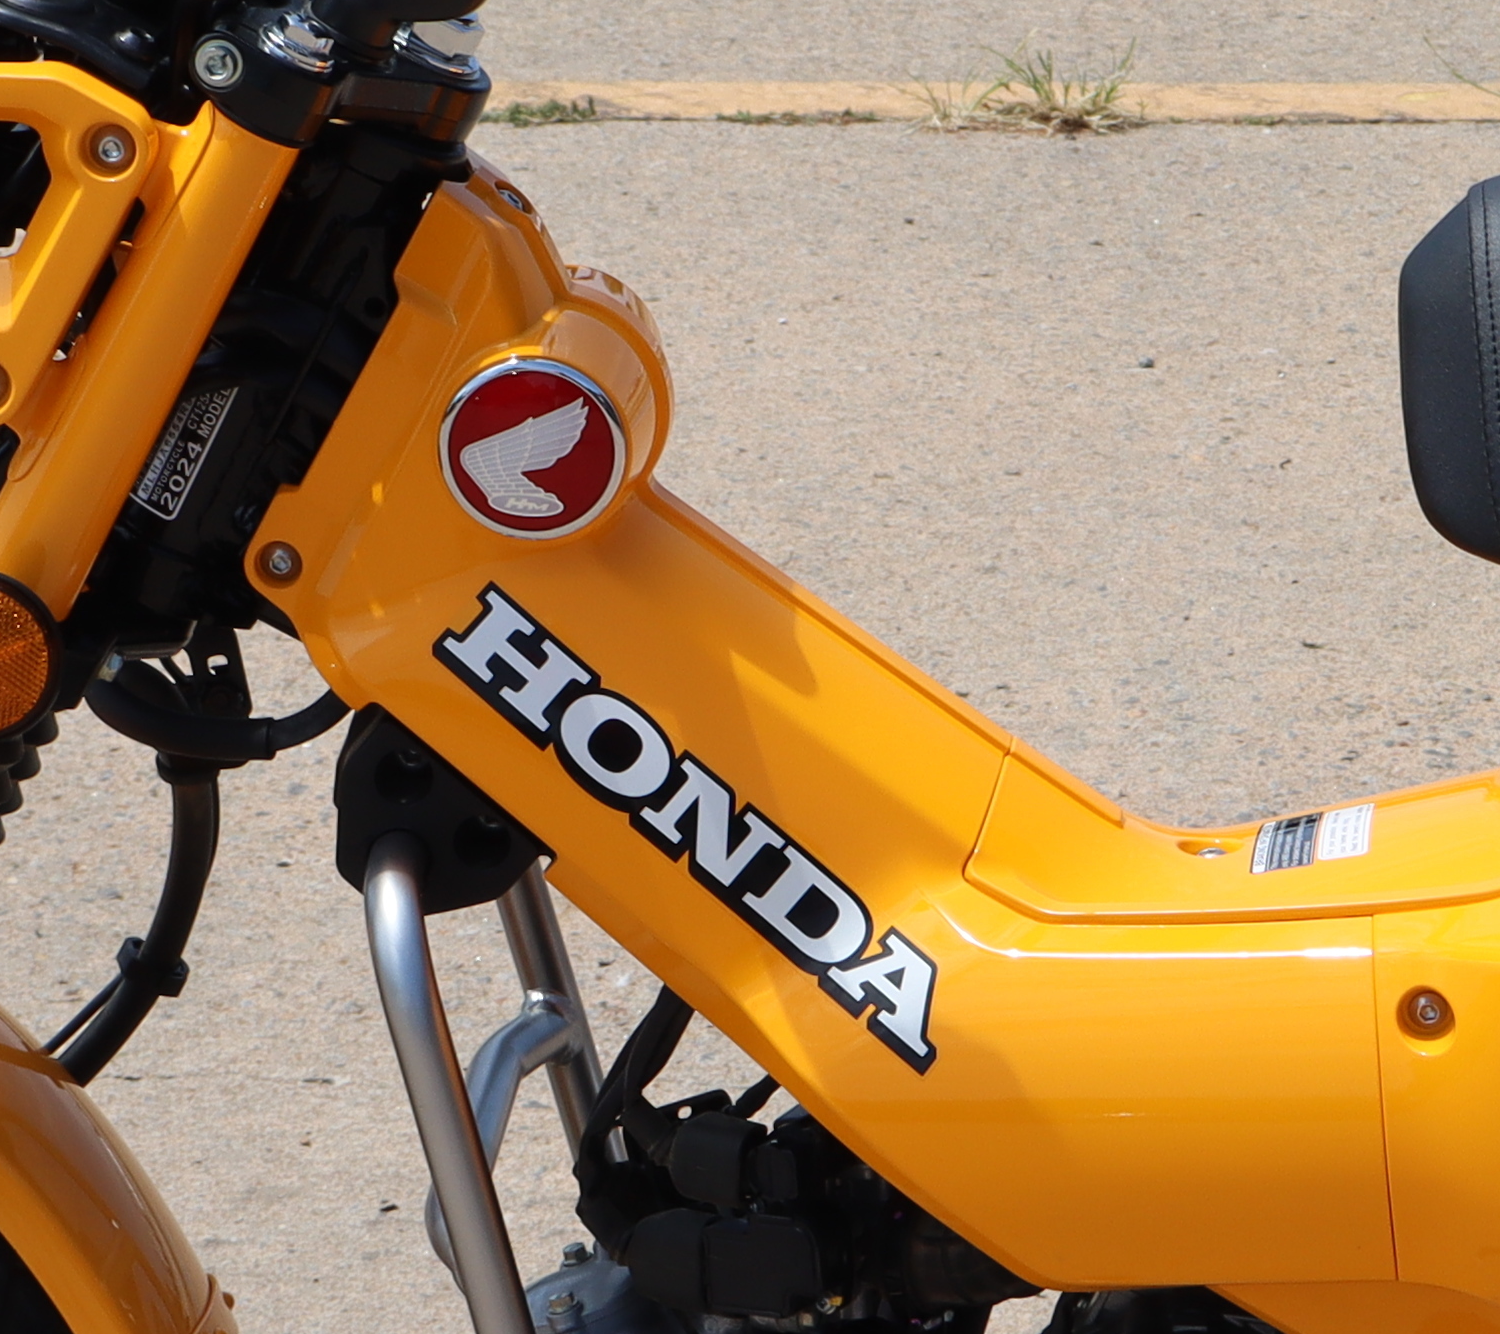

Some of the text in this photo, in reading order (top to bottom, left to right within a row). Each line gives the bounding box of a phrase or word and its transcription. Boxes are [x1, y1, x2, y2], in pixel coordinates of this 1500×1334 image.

[150, 440, 187, 502] MOTORCYCLE
[160, 387, 233, 512] 2024 MODEL
[436, 584, 934, 1069] HONDA
